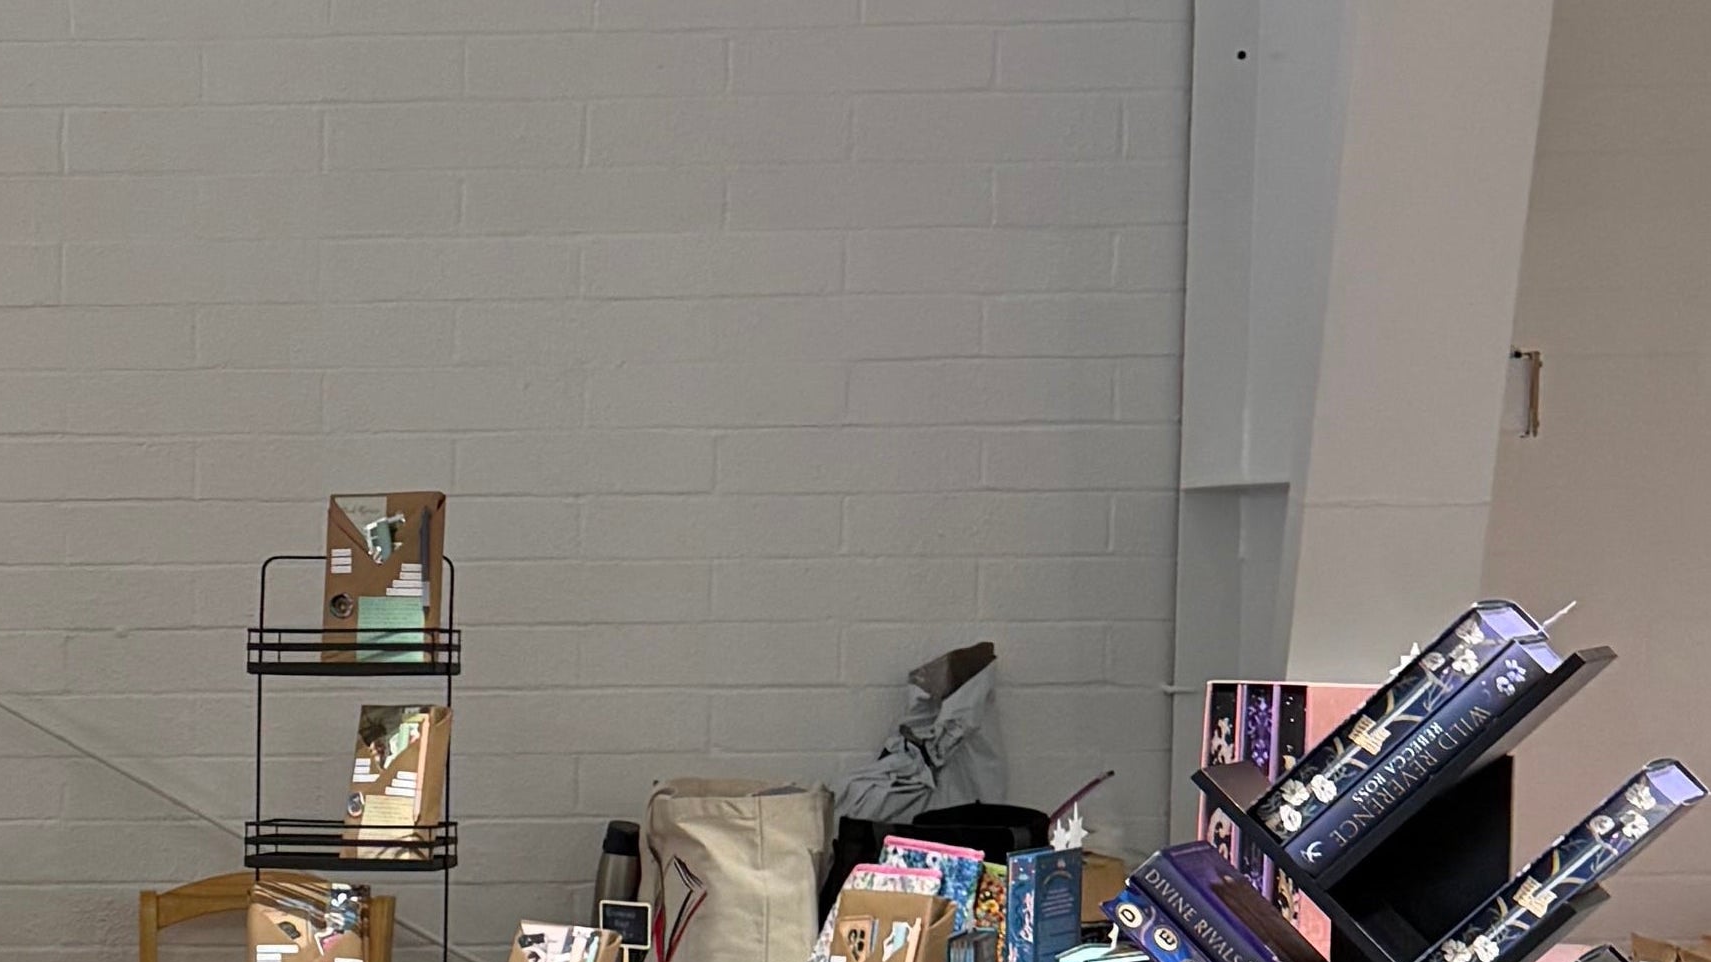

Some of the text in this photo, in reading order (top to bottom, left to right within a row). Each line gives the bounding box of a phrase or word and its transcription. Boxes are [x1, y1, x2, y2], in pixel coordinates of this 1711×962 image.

[1330, 706, 1491, 847] WILD REVERENCE
[1352, 721, 1444, 803] REBECCA ROSS
[1145, 868, 1198, 921] DIVINE
